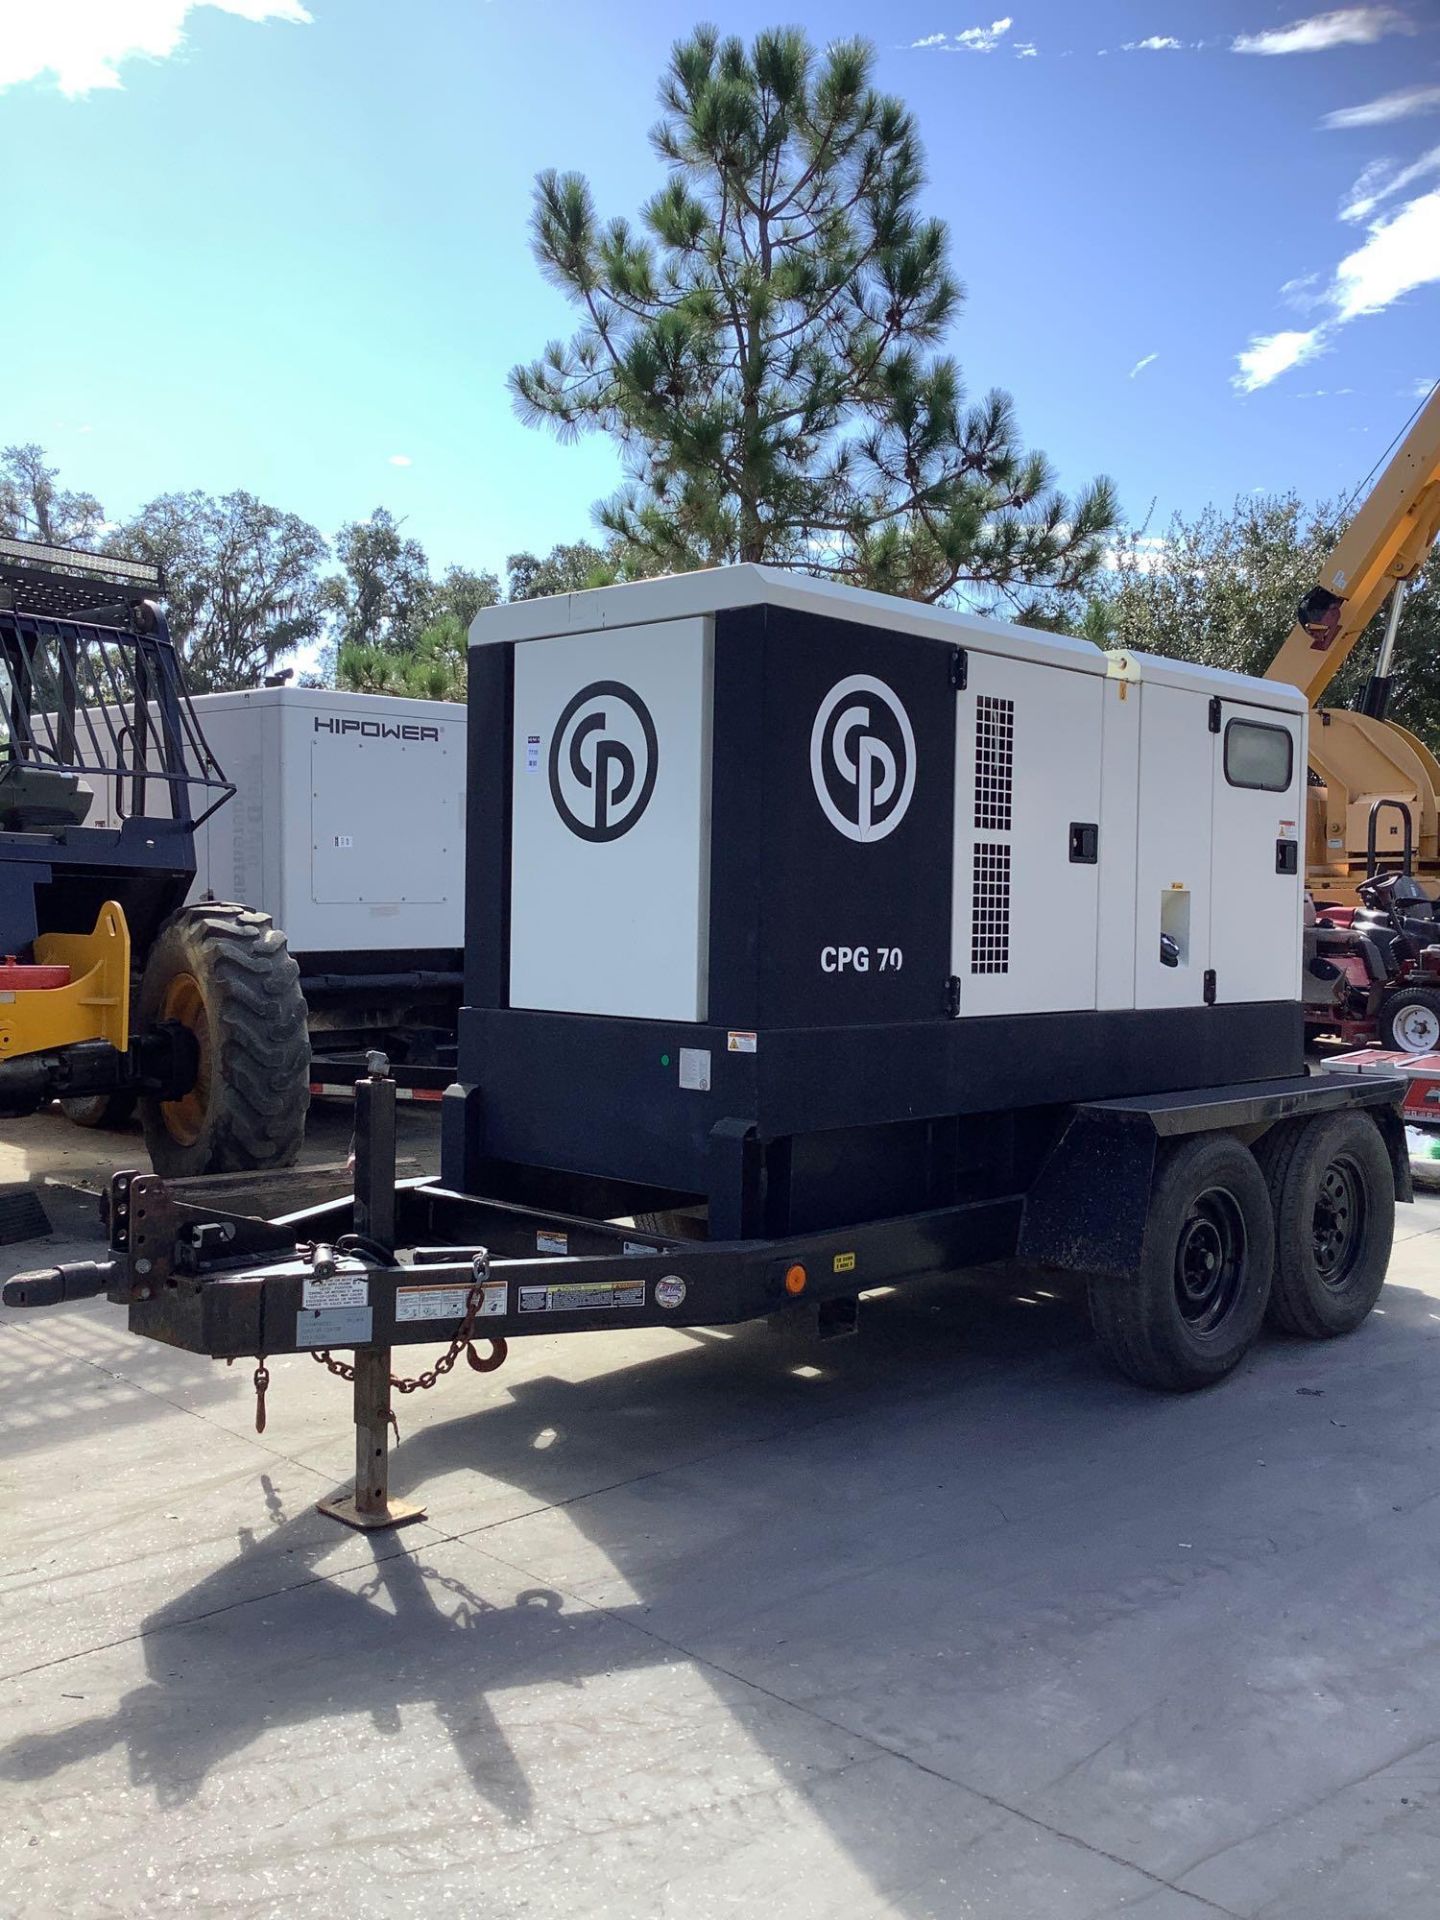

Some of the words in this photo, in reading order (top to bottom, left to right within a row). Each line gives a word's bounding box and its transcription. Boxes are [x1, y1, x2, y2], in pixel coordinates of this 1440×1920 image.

[314, 716, 439, 742] HIPOWER
[820, 946, 870, 973] CPG
[876, 947, 903, 972] 70
